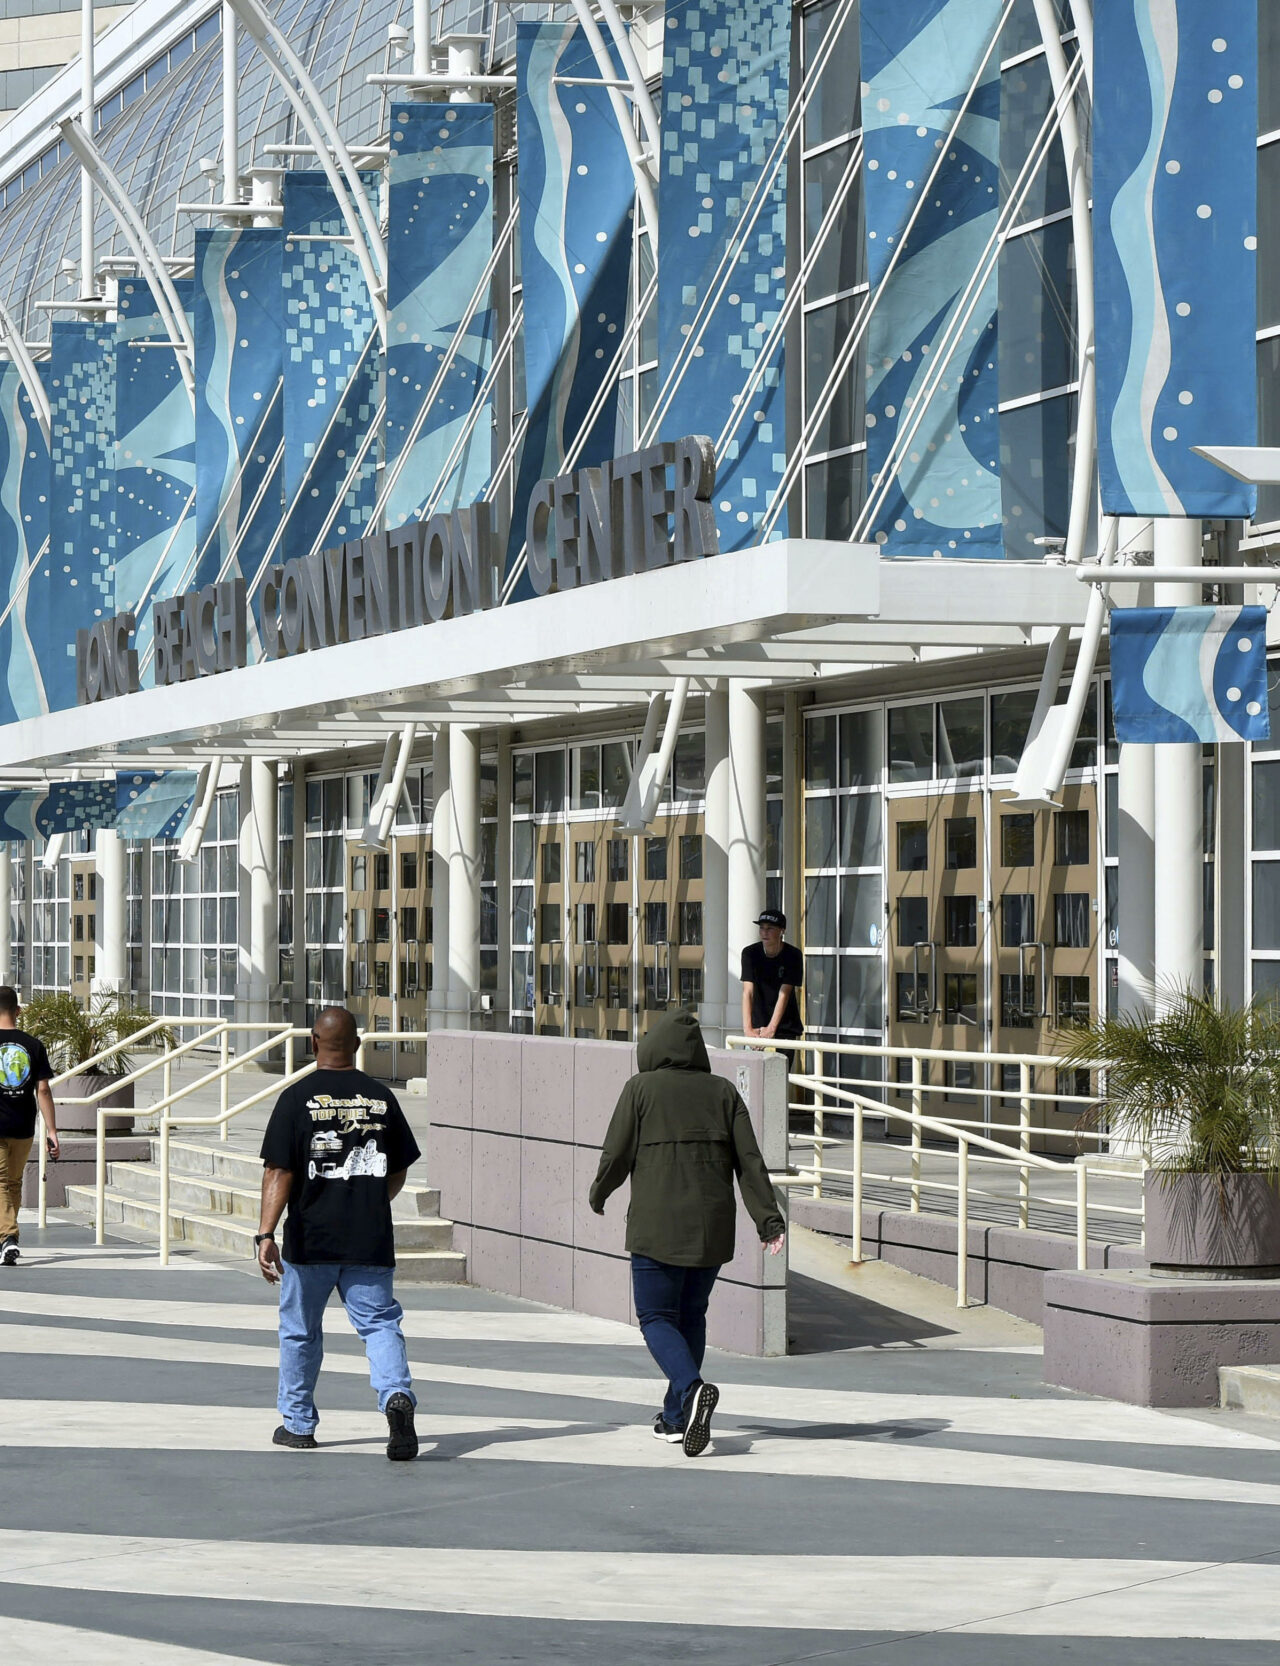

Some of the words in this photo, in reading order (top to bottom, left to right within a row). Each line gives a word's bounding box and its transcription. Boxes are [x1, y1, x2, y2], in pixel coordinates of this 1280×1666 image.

[153, 577, 248, 687] BEACH
[259, 501, 493, 659] CONVENTION
[526, 434, 719, 596] CENTER
[309, 1108, 337, 1121] TOP
[338, 1108, 370, 1120] FUEL
